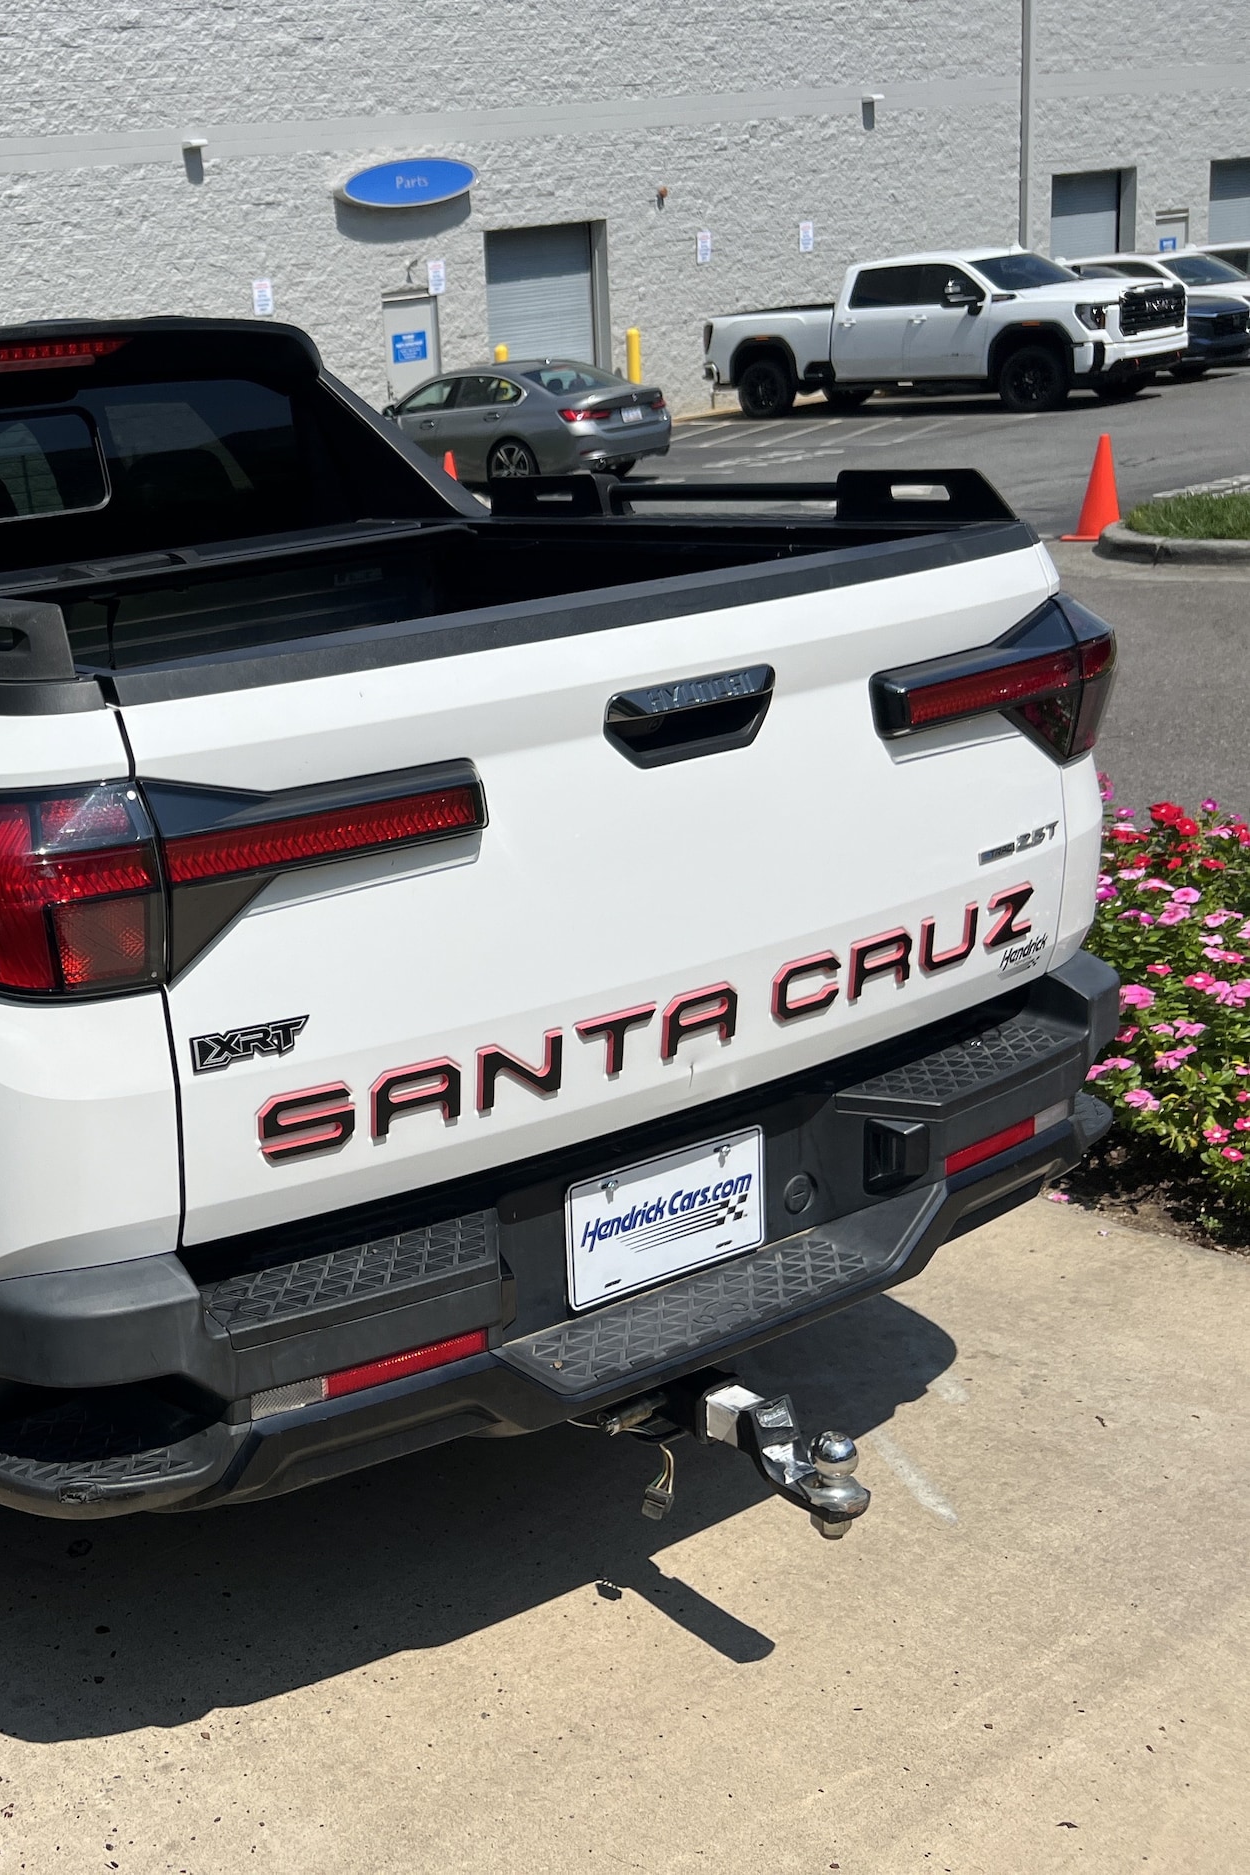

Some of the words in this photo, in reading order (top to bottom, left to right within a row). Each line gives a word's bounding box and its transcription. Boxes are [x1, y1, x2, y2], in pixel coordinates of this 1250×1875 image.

[395, 175, 429, 189] Parts
[1000, 933, 1048, 971] Hendrick
[192, 1014, 309, 1069] XRT
[257, 981, 738, 1163] SANTA
[772, 880, 1034, 1022] CRUZ
